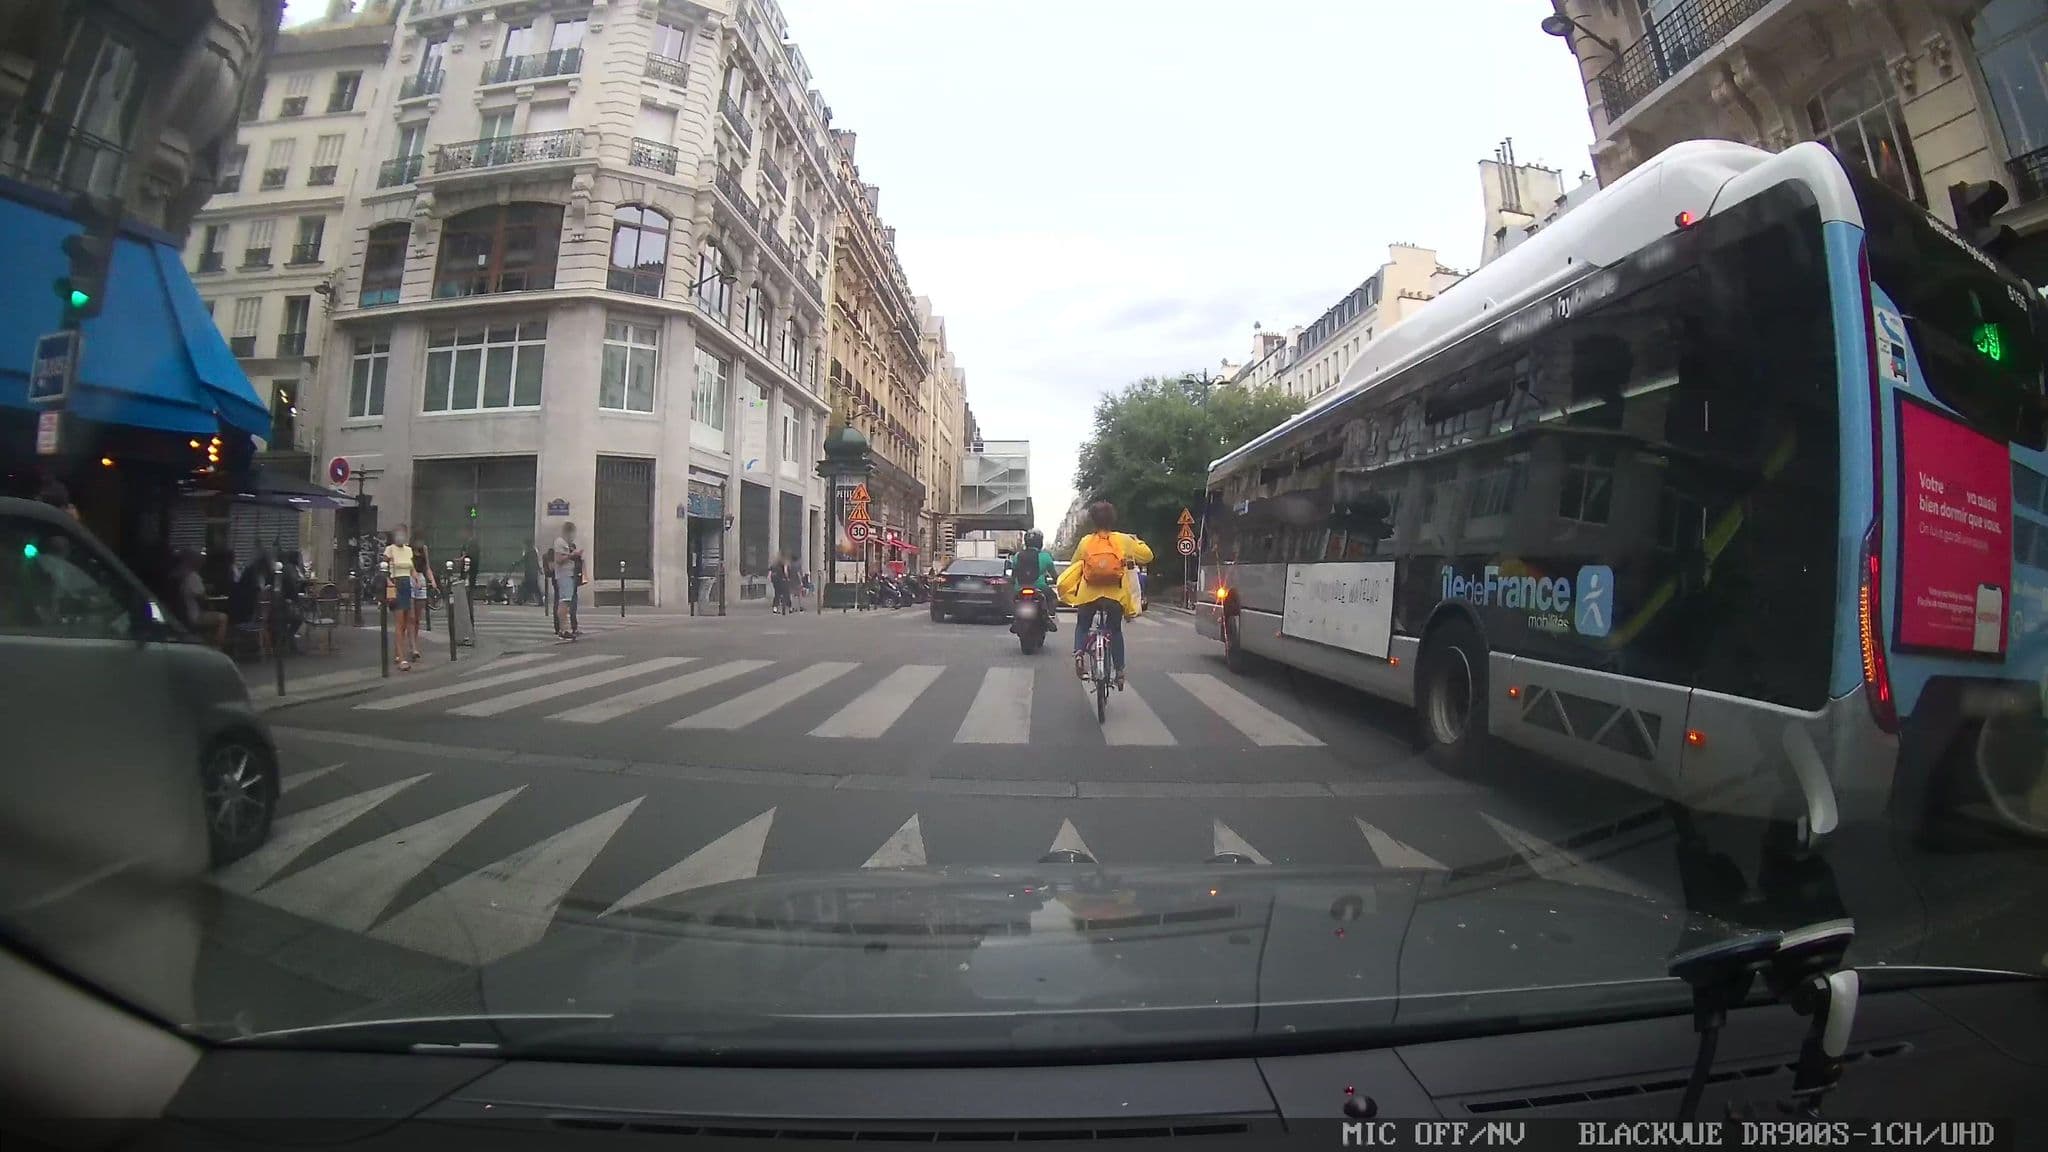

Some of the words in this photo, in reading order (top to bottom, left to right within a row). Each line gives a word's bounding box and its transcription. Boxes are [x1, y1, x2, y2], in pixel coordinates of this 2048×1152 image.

[1919, 471, 1944, 494] Votre
[1919, 493, 1939, 515] bien
[1940, 502, 1968, 524] dormir
[1968, 513, 1983, 530] que
[852, 526, 866, 537] 30
[1181, 542, 1191, 550] 30
